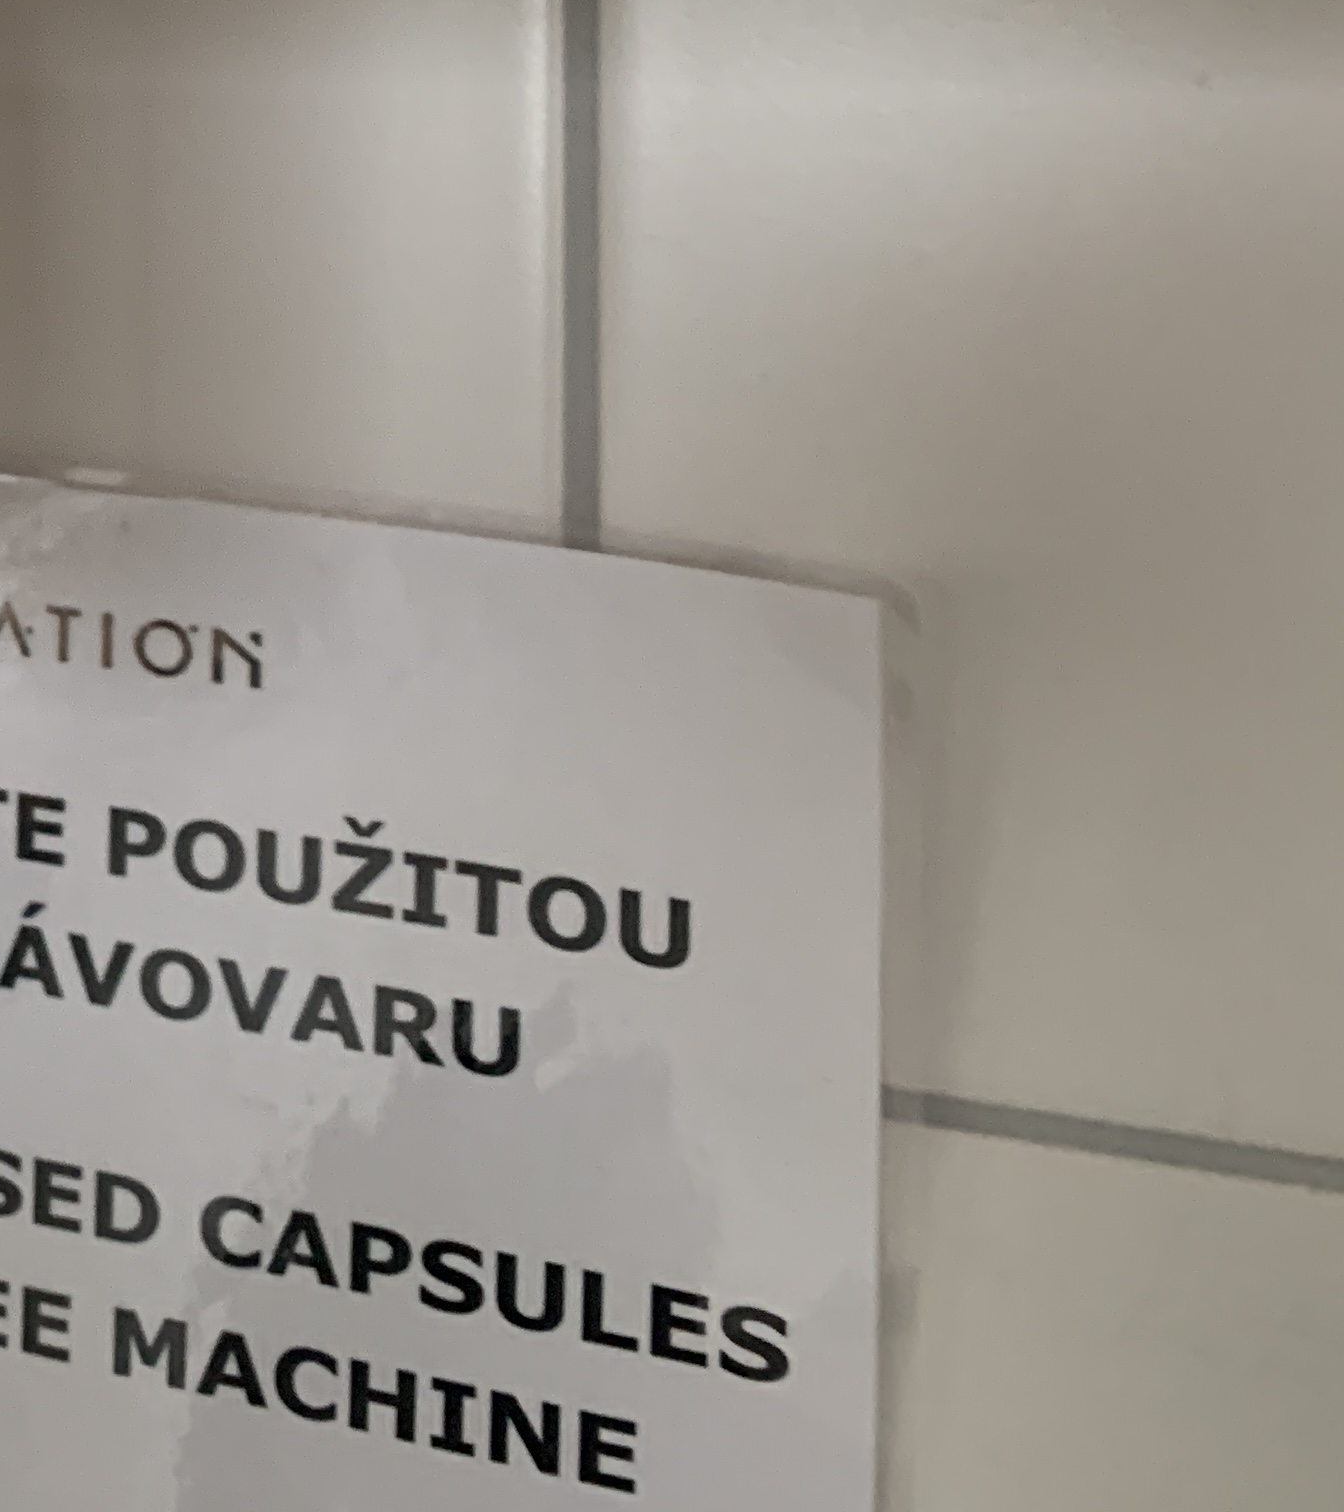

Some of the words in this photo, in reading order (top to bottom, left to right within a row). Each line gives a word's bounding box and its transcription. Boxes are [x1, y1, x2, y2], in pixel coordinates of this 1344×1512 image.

[107, 813, 692, 970] POUŽITOU
[199, 1195, 792, 1384] CAPSULES
[112, 1304, 639, 1495] MACHINE
